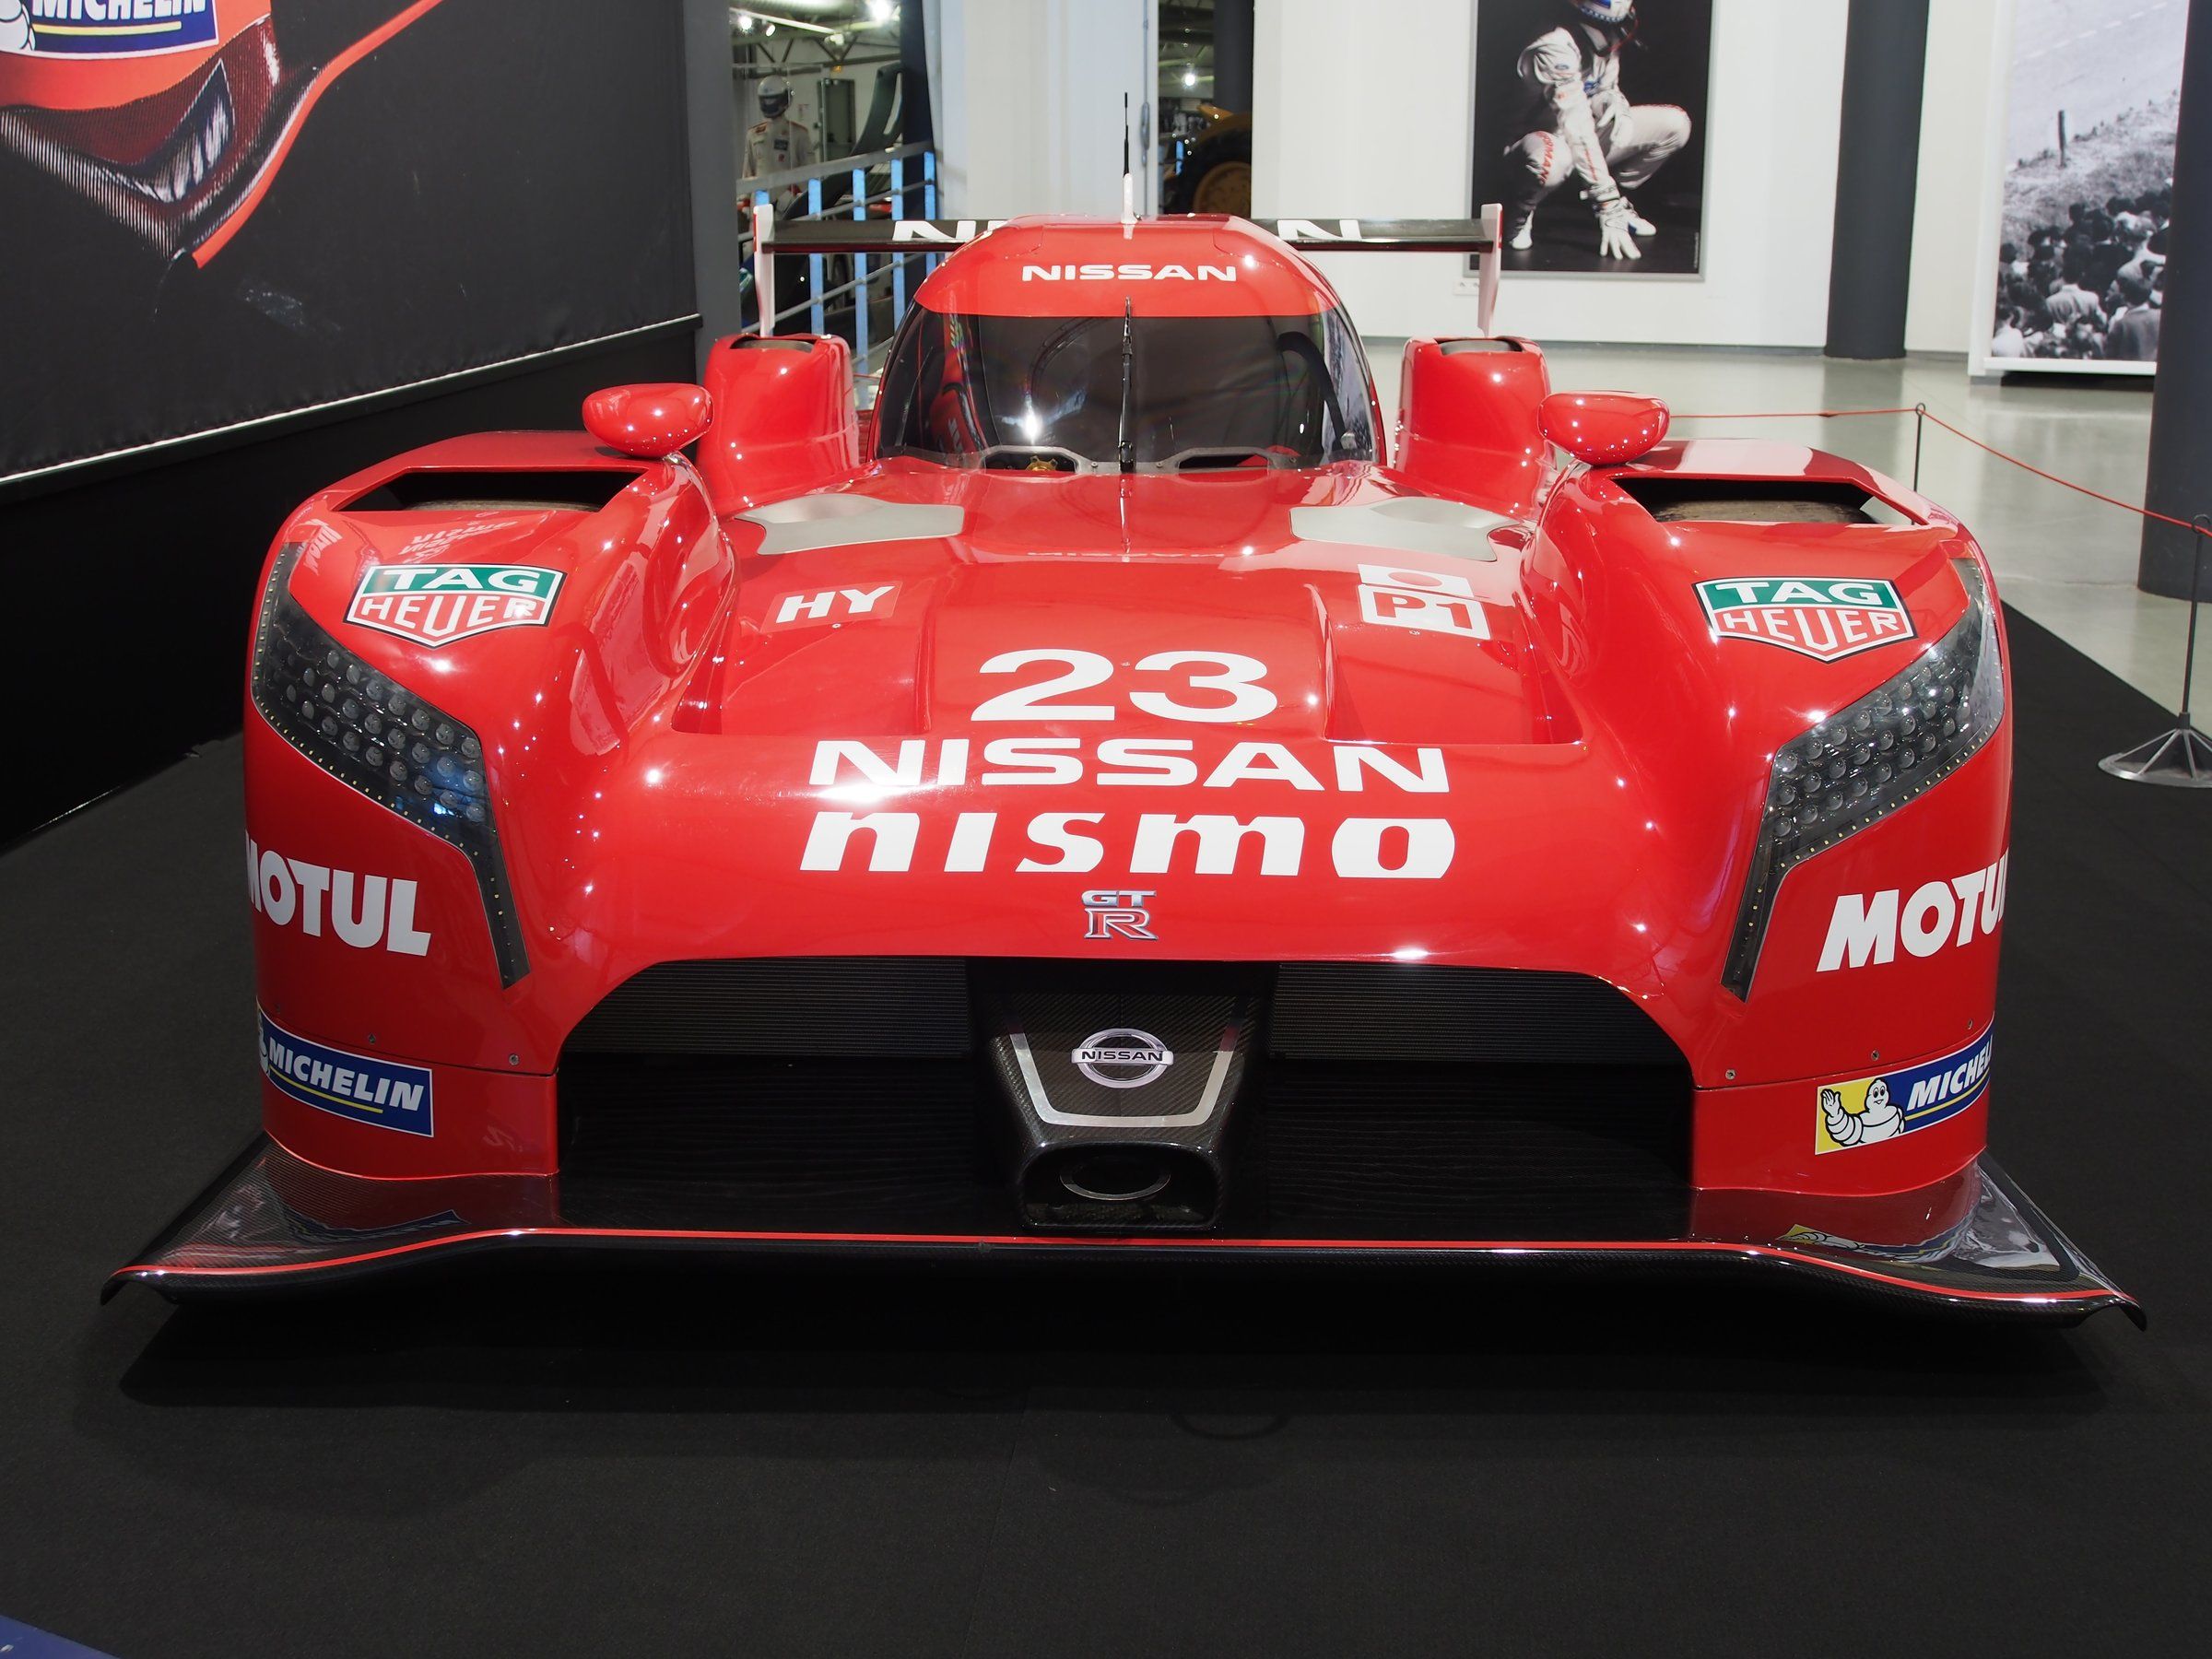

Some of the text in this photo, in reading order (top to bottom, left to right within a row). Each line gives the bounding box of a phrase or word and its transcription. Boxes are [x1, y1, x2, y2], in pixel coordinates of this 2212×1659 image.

[1022, 265, 1237, 281] NISSAN
[383, 568, 539, 593] TAG
[1715, 582, 1883, 606] TAG
[360, 595, 537, 637] HEUER
[775, 585, 896, 624] HY
[1373, 591, 1473, 629] P1
[1723, 608, 1900, 652] HEUER
[971, 650, 1277, 724] 23
[809, 738, 1450, 794] NISSAN
[800, 812, 1455, 879] nismo
[245, 830, 431, 957] MOTUL
[1081, 889, 1158, 907] GT
[1816, 847, 2009, 971] MOTU
[1084, 907, 1159, 940] R
[269, 1037, 424, 1112] MICHELIN
[1081, 1051, 1163, 1062] NISSAN
[1906, 1033, 1994, 1112] MICHEL
